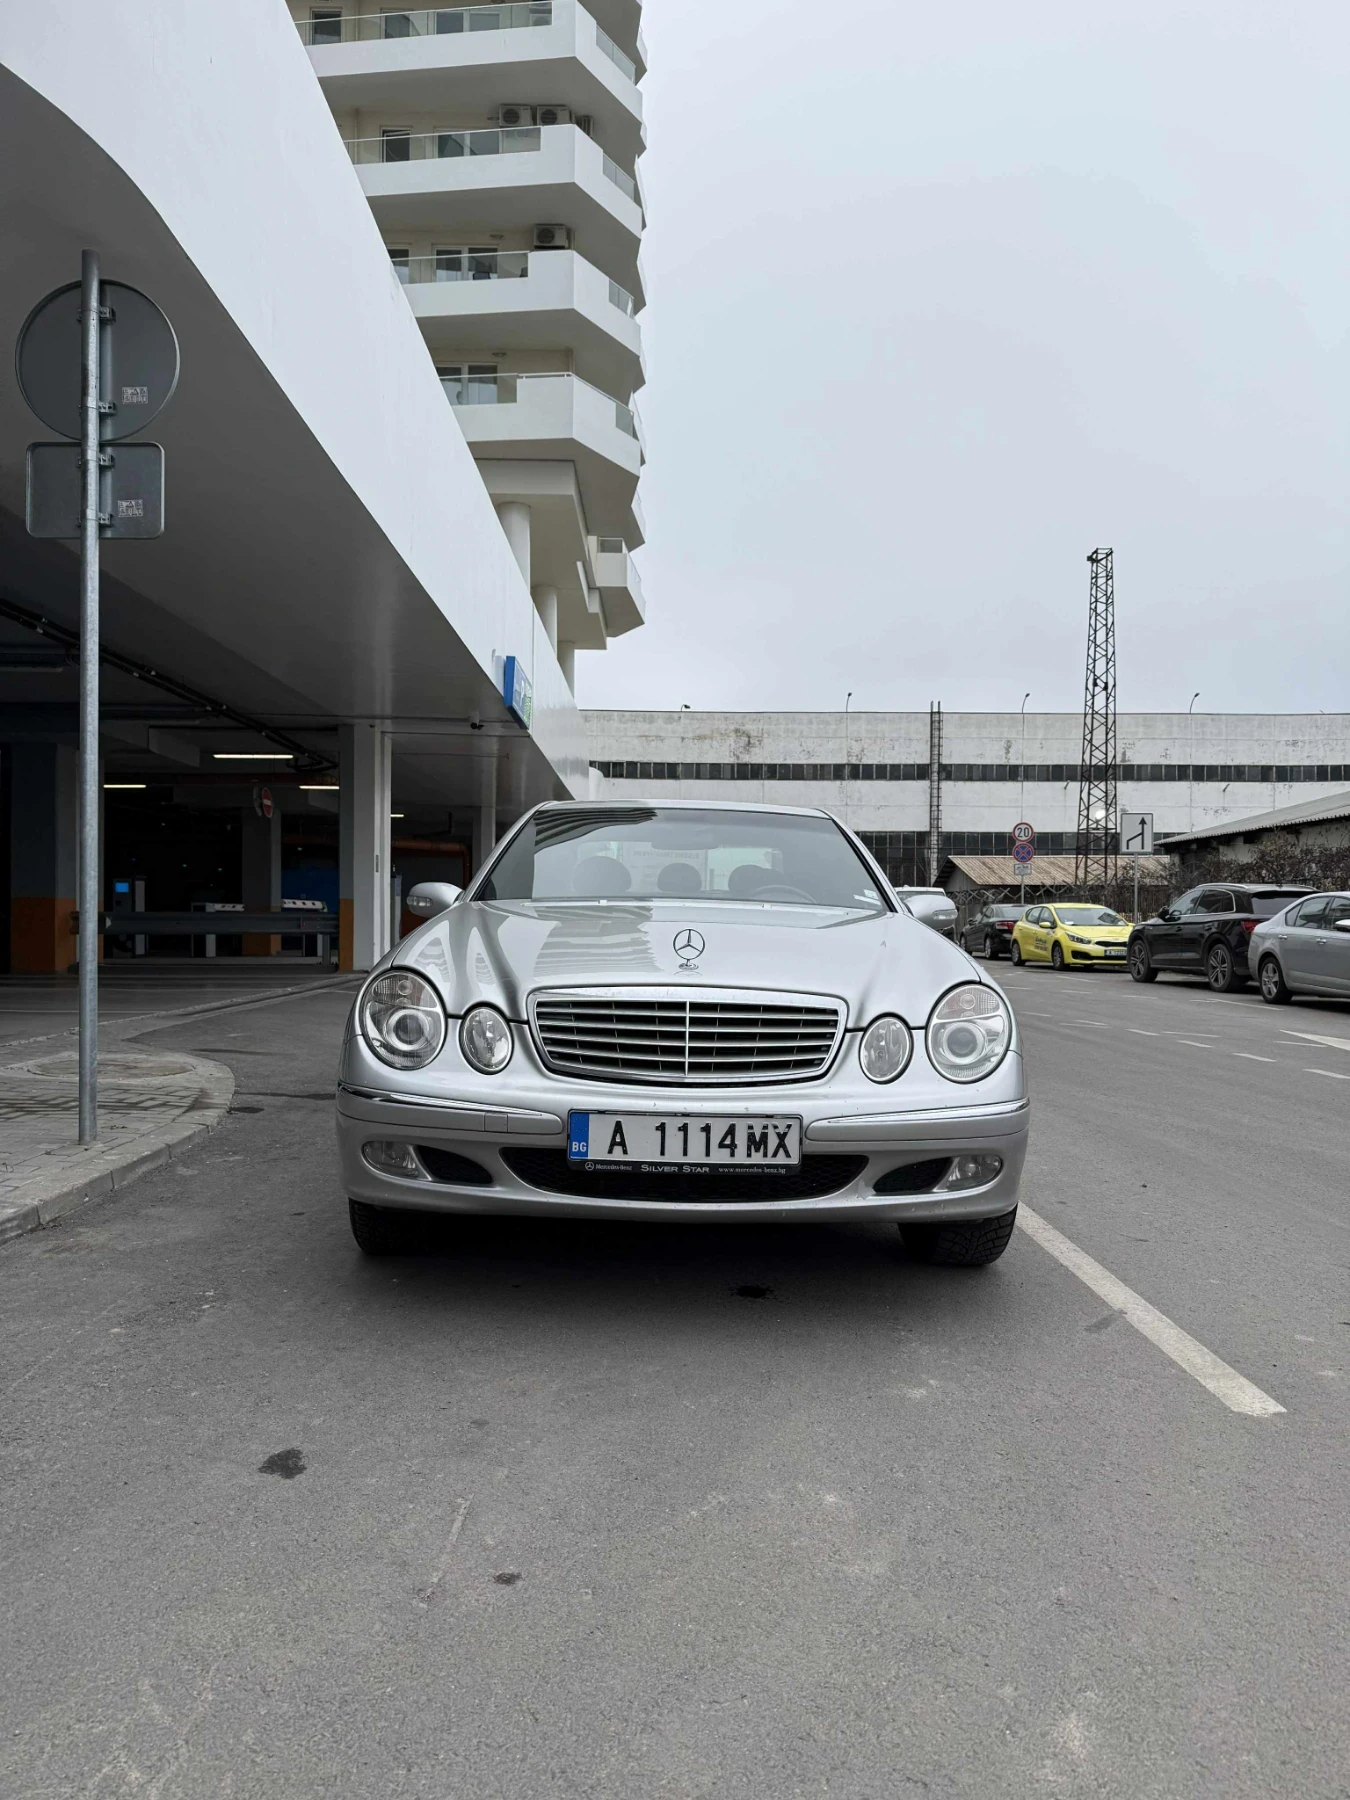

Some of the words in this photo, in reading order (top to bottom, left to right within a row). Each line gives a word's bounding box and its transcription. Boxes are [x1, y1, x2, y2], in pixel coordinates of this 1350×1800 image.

[1017, 827, 1030, 838] 20
[607, 1120, 628, 1155] A
[572, 1141, 587, 1152] BG
